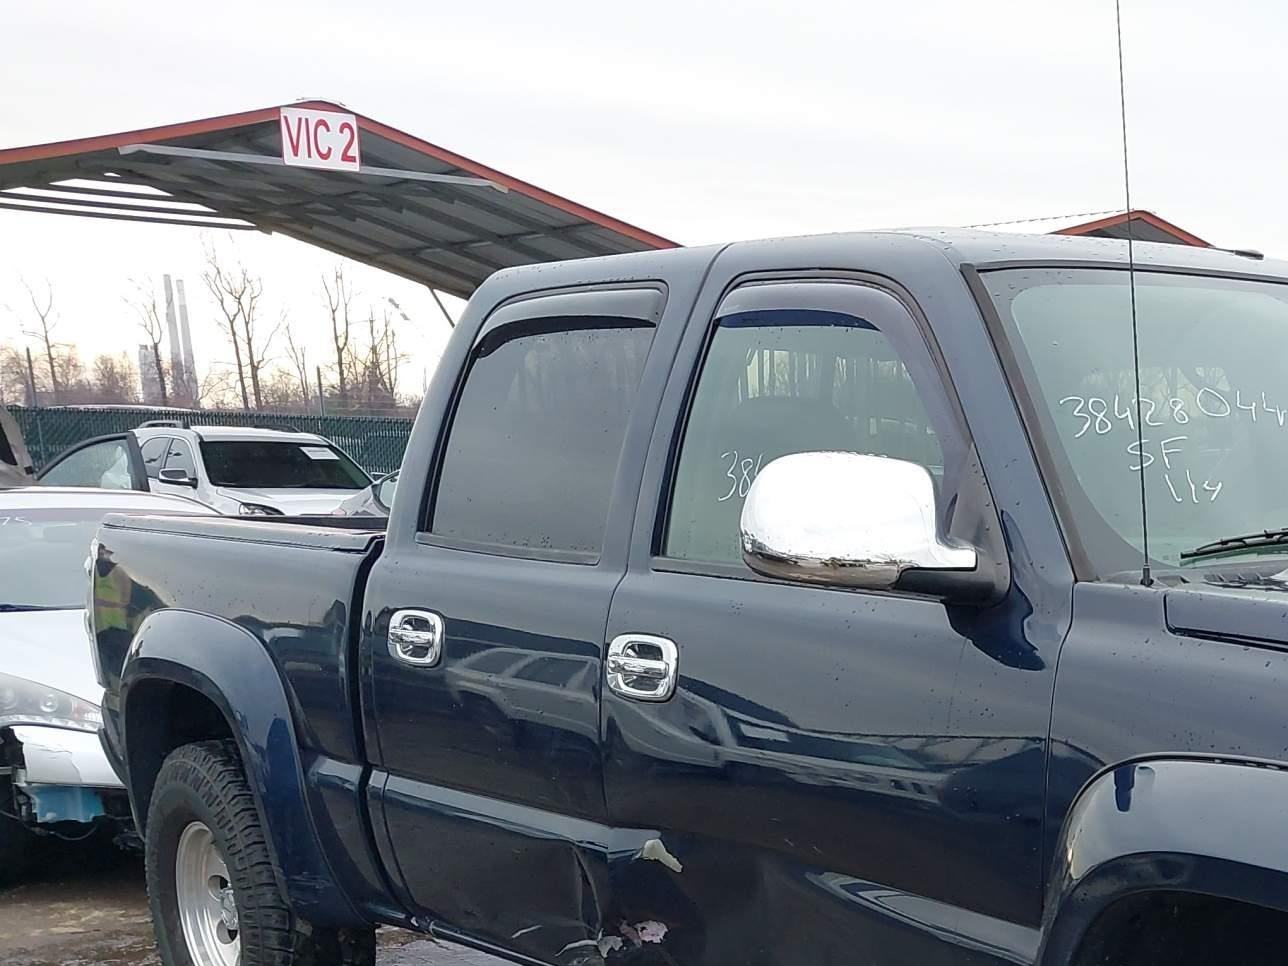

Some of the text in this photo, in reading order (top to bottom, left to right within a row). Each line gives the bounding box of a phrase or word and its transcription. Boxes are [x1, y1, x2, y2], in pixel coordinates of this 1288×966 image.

[283, 115, 357, 164] VIC 2
[1059, 387, 1288, 438] 38428044
[1127, 435, 1188, 471] SF
